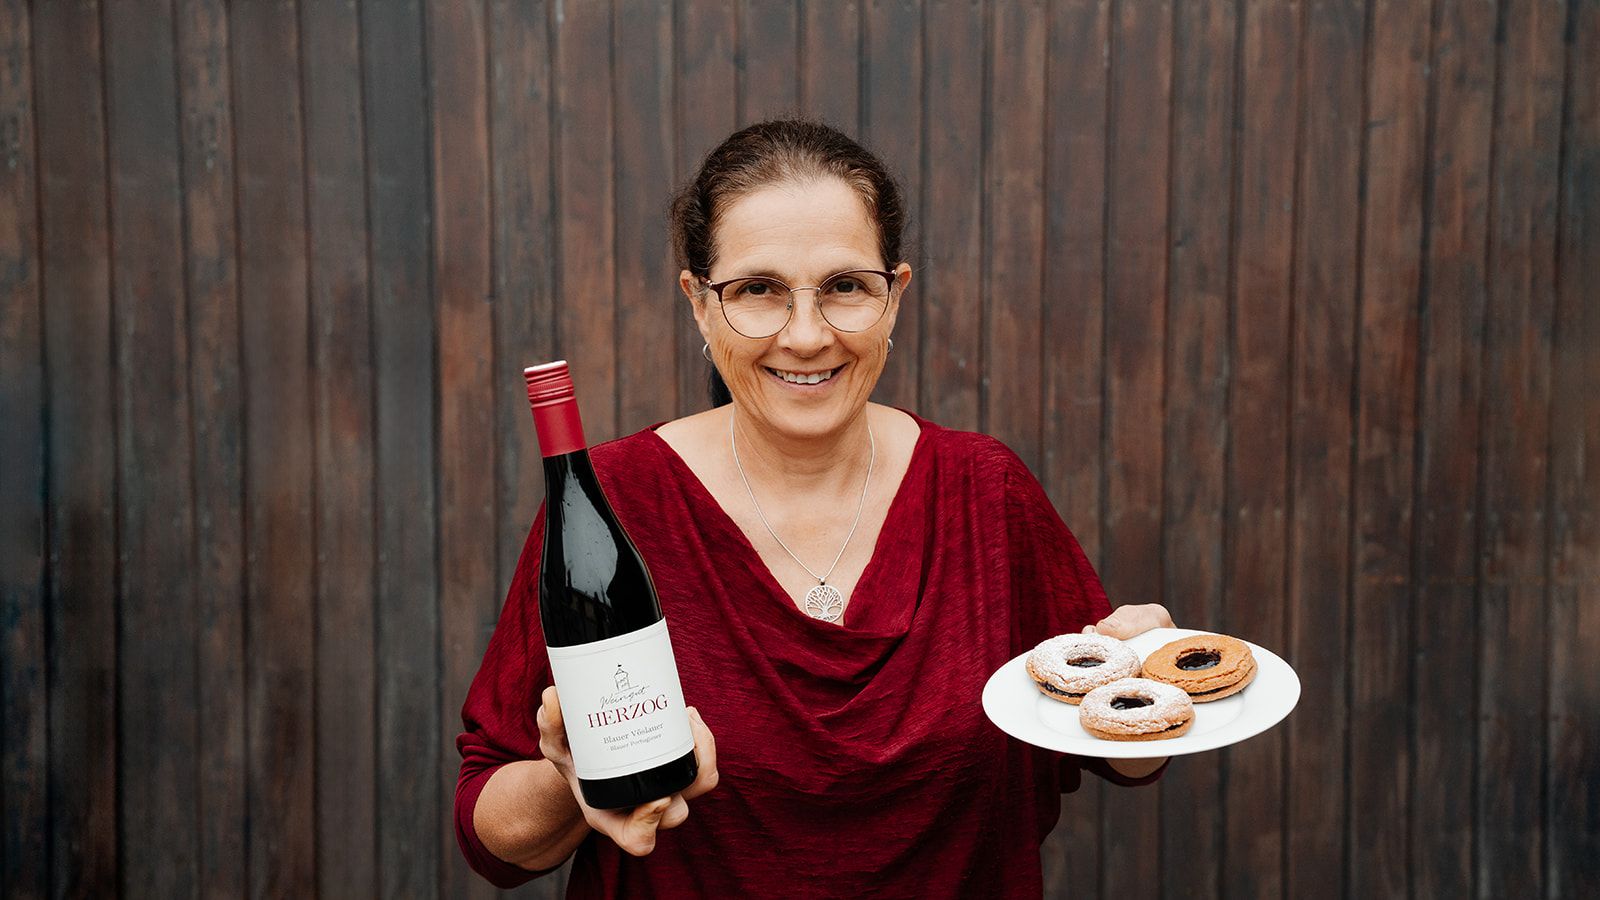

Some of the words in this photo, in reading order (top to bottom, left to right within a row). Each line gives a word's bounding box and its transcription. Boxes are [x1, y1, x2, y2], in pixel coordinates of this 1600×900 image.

[588, 694, 668, 728] HERZOG
[603, 733, 629, 744] Blauer
[631, 723, 664, 737] Vöslauer
[610, 743, 629, 751] Blauer
